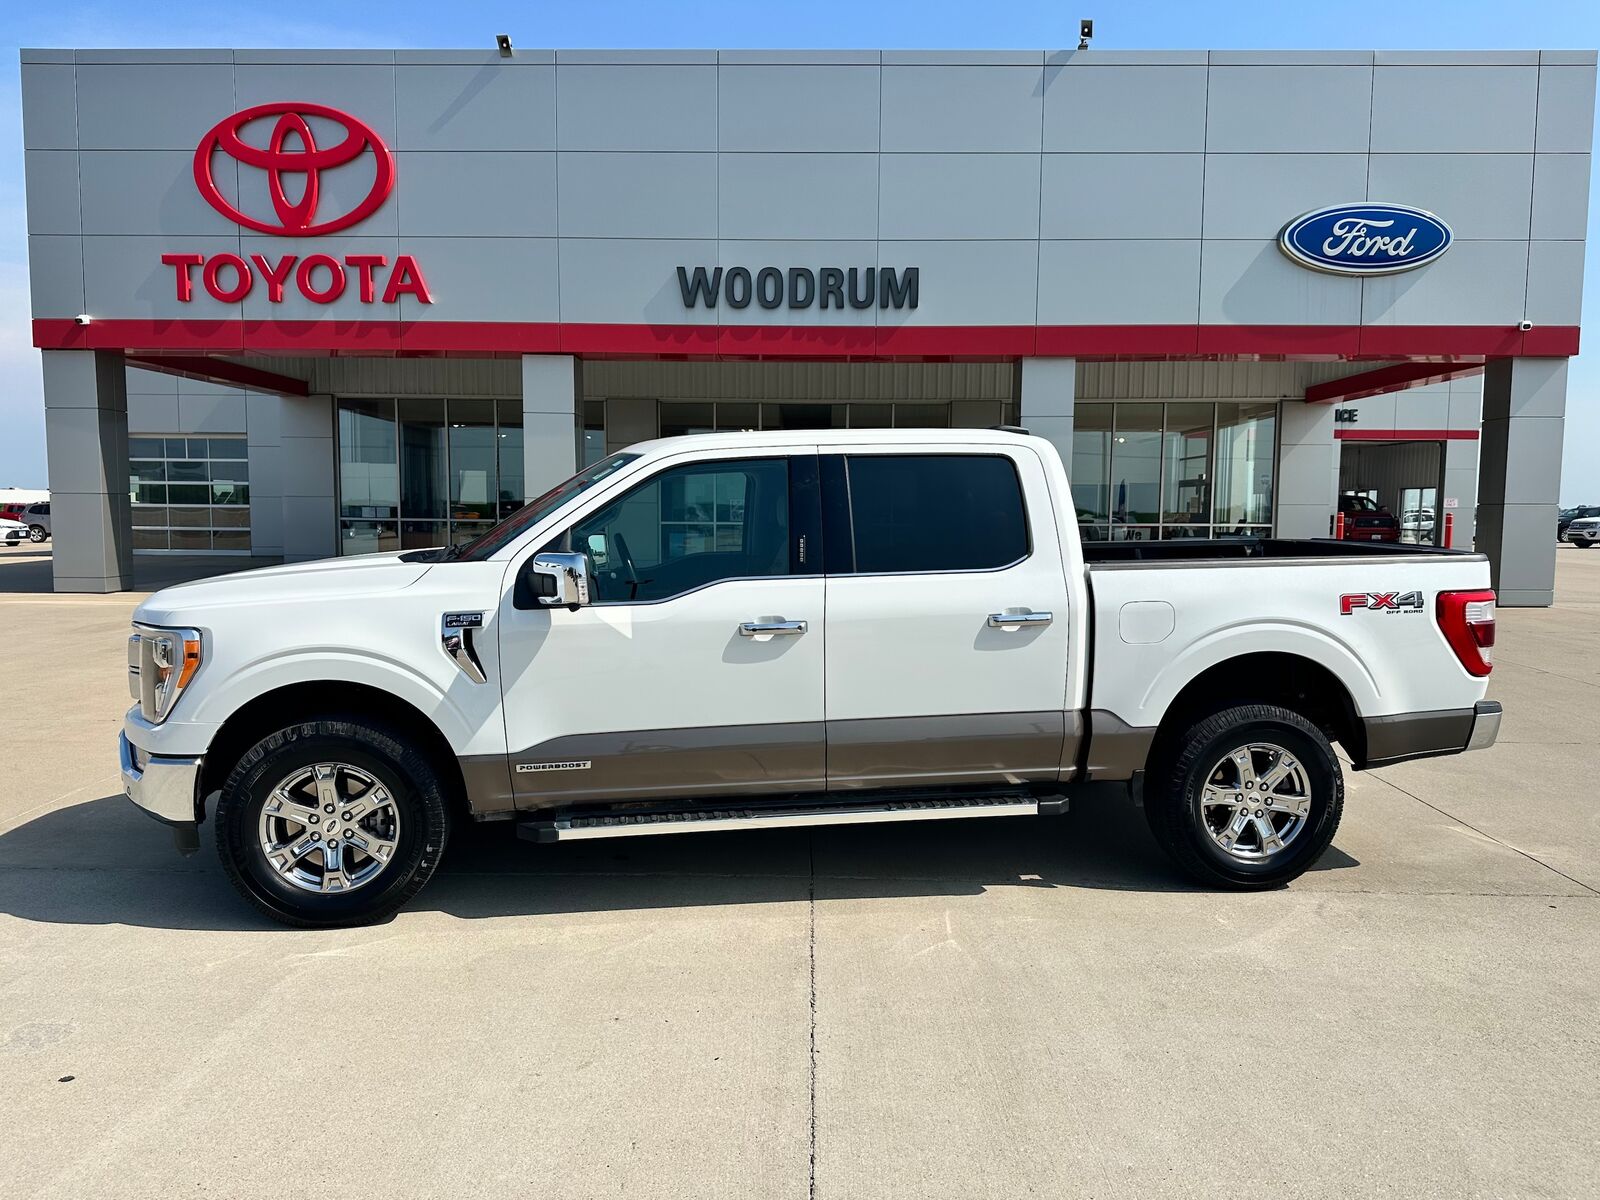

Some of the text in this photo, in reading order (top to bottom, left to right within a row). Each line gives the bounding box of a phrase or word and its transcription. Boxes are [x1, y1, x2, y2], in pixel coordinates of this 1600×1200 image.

[1322, 217, 1418, 257] Ford
[161, 253, 434, 304] TOYOTA
[676, 266, 920, 310] WOODRUM
[1335, 408, 1358, 422] ICE
[1339, 591, 1424, 615] FX4
[447, 614, 481, 622] F-150
[519, 762, 587, 770] POWERBOOST
